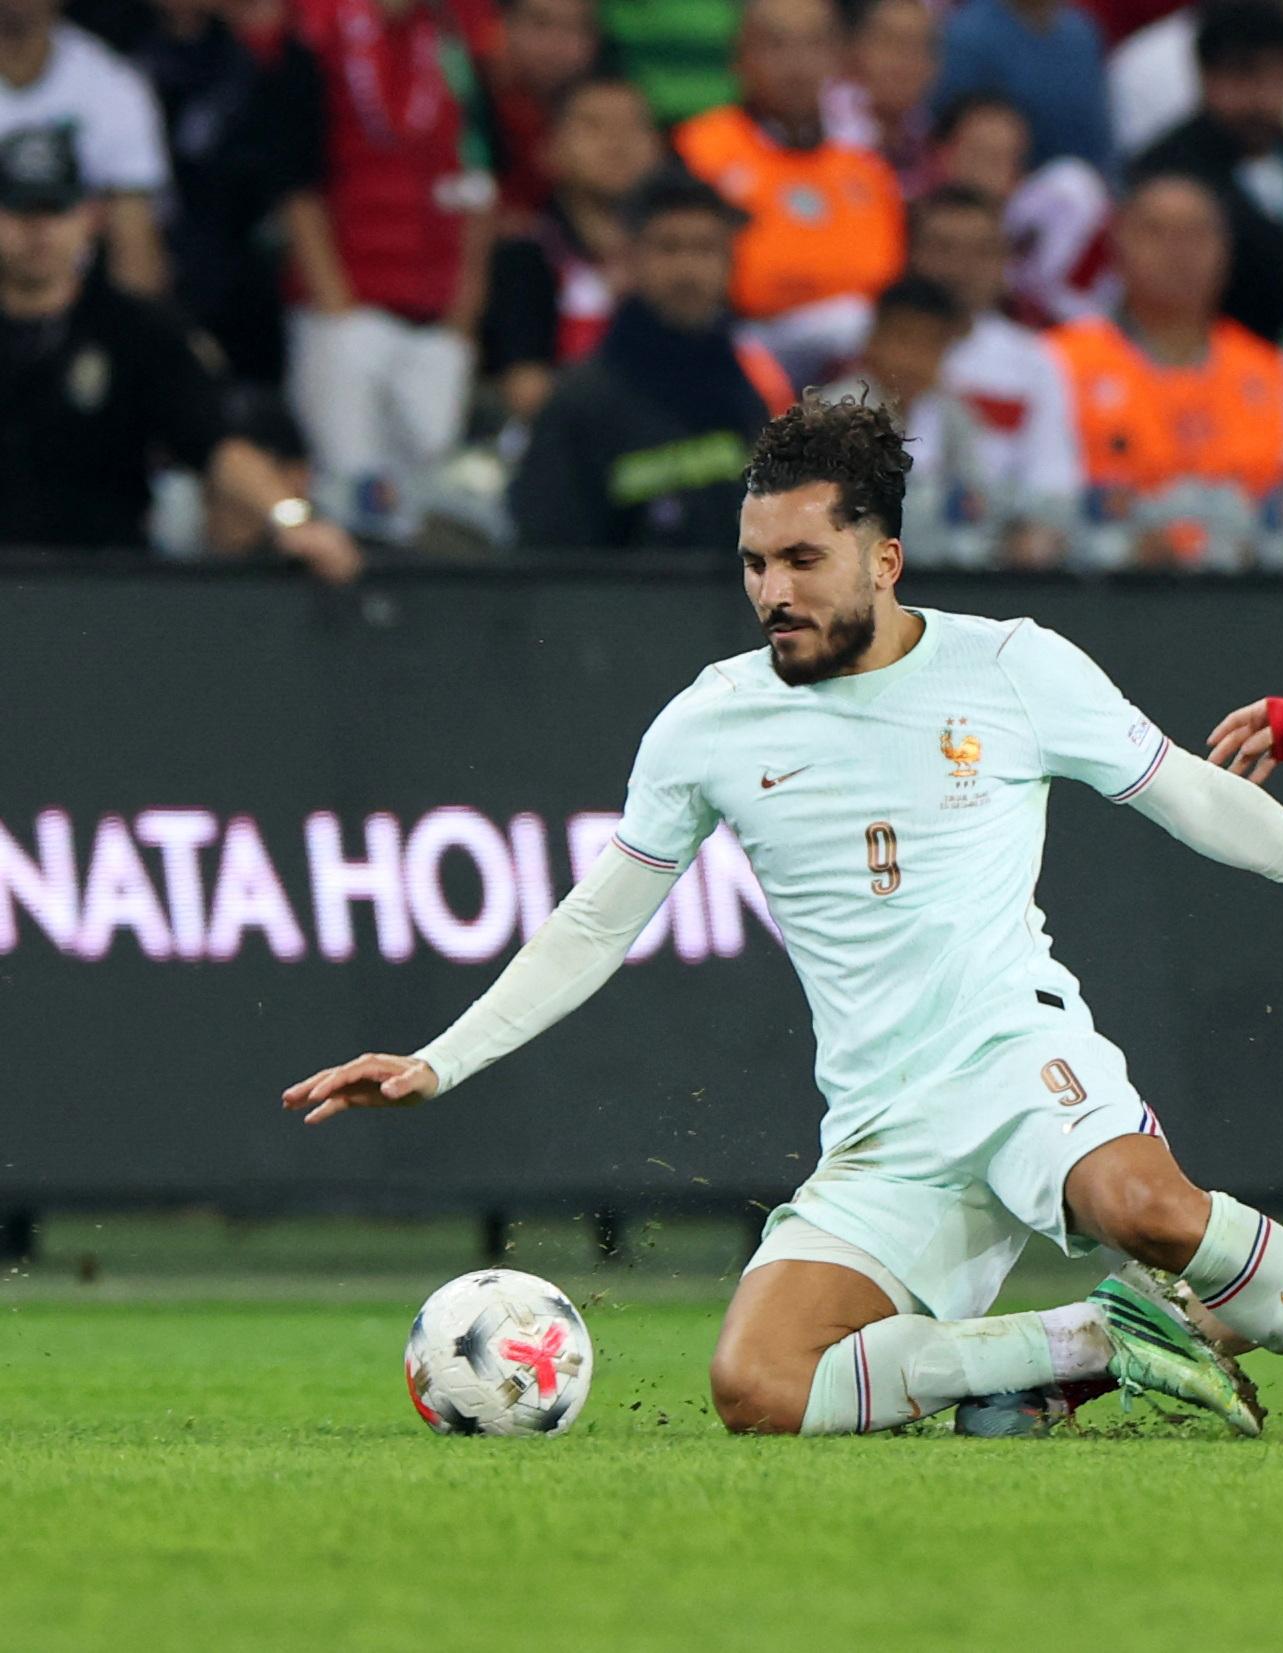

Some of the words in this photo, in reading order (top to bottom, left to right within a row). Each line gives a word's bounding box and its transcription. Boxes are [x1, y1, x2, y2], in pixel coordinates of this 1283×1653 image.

[0, 804, 305, 962] NATA
[865, 821, 900, 896] 9
[1041, 1057, 1087, 1107] 9
